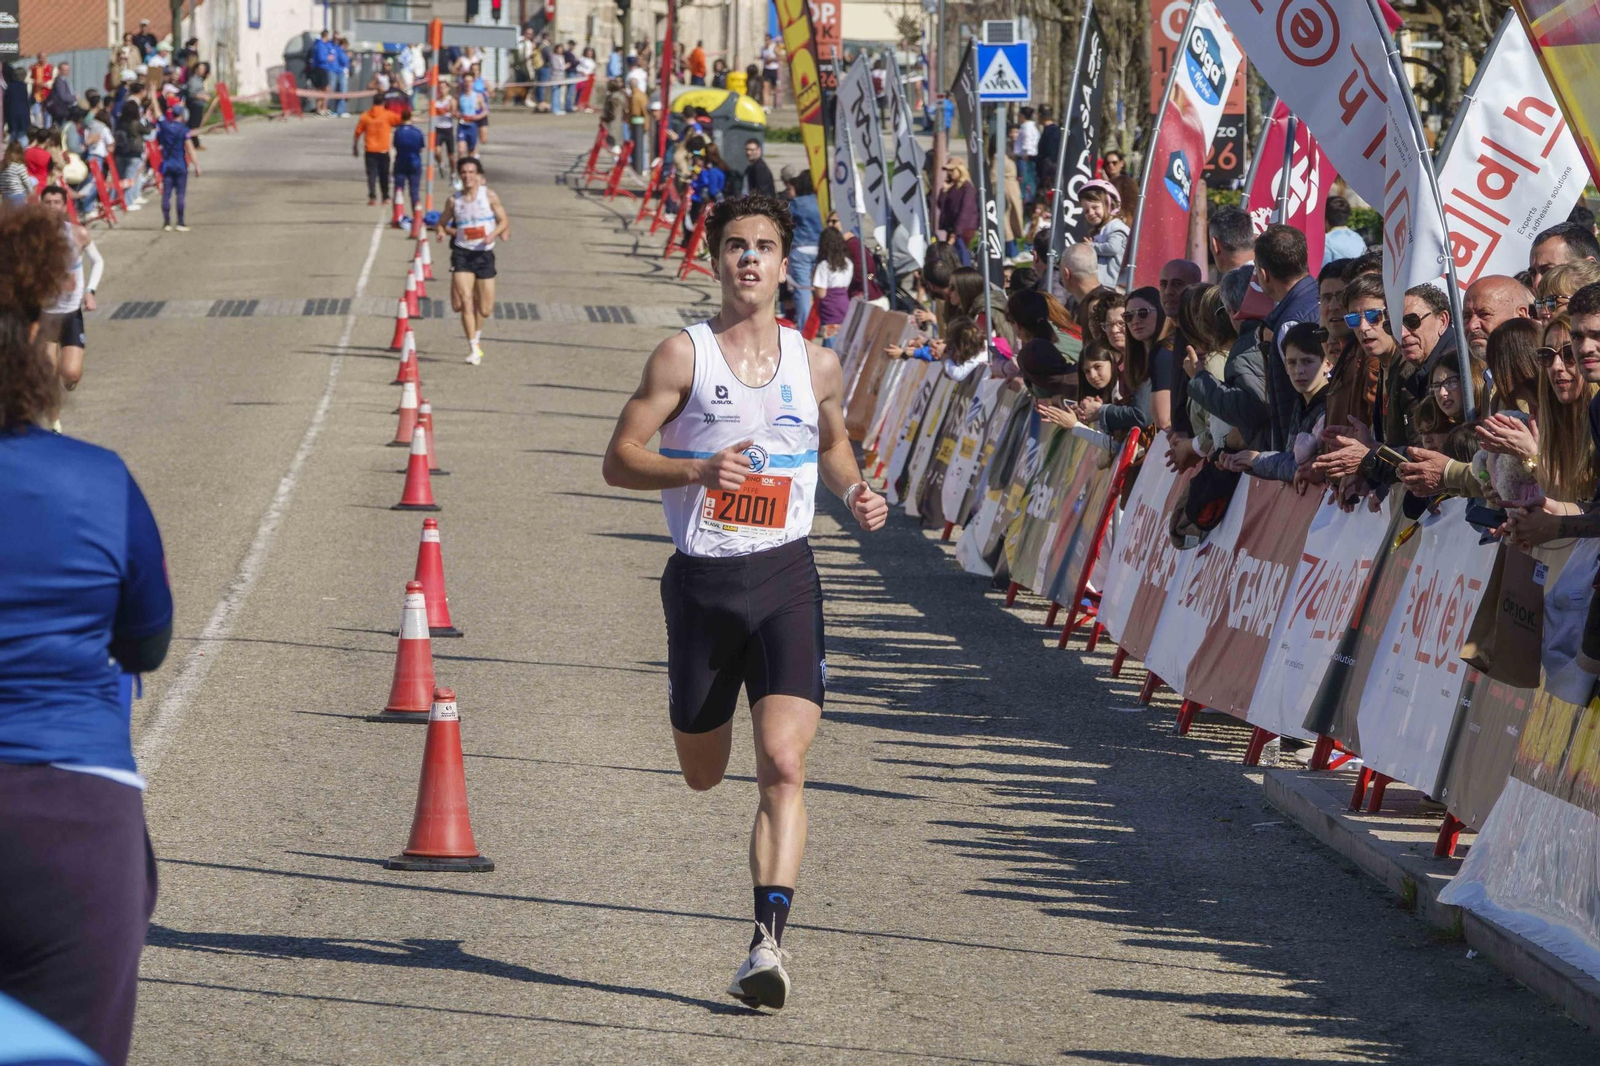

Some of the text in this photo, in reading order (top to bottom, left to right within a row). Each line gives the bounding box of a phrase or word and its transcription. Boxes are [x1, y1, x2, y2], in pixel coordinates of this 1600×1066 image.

[1191, 28, 1221, 86] Giga
[1516, 206, 1538, 236] Experts
[1527, 165, 1573, 241] in adhesive solutions
[718, 492, 777, 526] 2001
